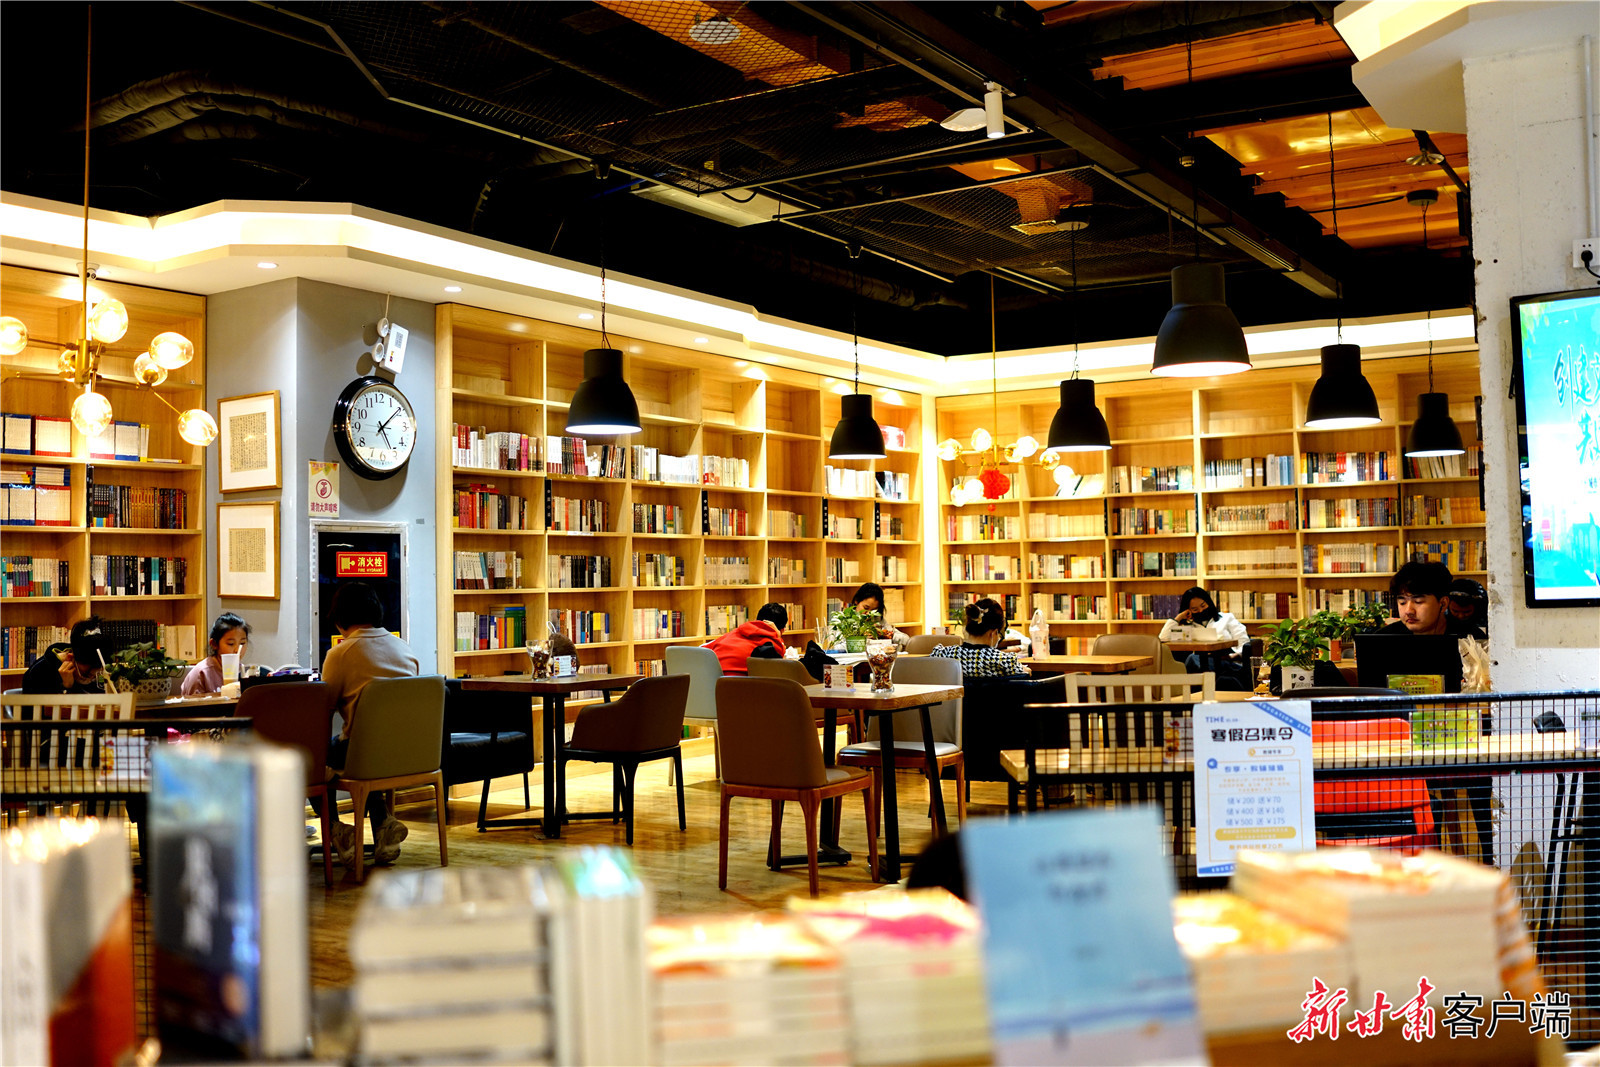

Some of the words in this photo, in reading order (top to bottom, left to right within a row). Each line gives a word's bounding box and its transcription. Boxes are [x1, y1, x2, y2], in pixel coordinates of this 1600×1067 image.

[365, 397, 374, 408] 11
[375, 393, 385, 404] 12
[389, 397, 393, 408] 1
[357, 408, 368, 420] 10
[354, 421, 361, 432] 9
[402, 421, 409, 432] 3
[358, 436, 366, 447] 8
[398, 436, 405, 447] 4
[369, 447, 375, 458] 7
[379, 450, 386, 462] 6
[310, 501, 338, 513] 请勿大声喧哗
[357, 557, 382, 567] 消火栓
[1205, 716, 1225, 724] TIME
[1211, 726, 1294, 742] 寒假召集令
